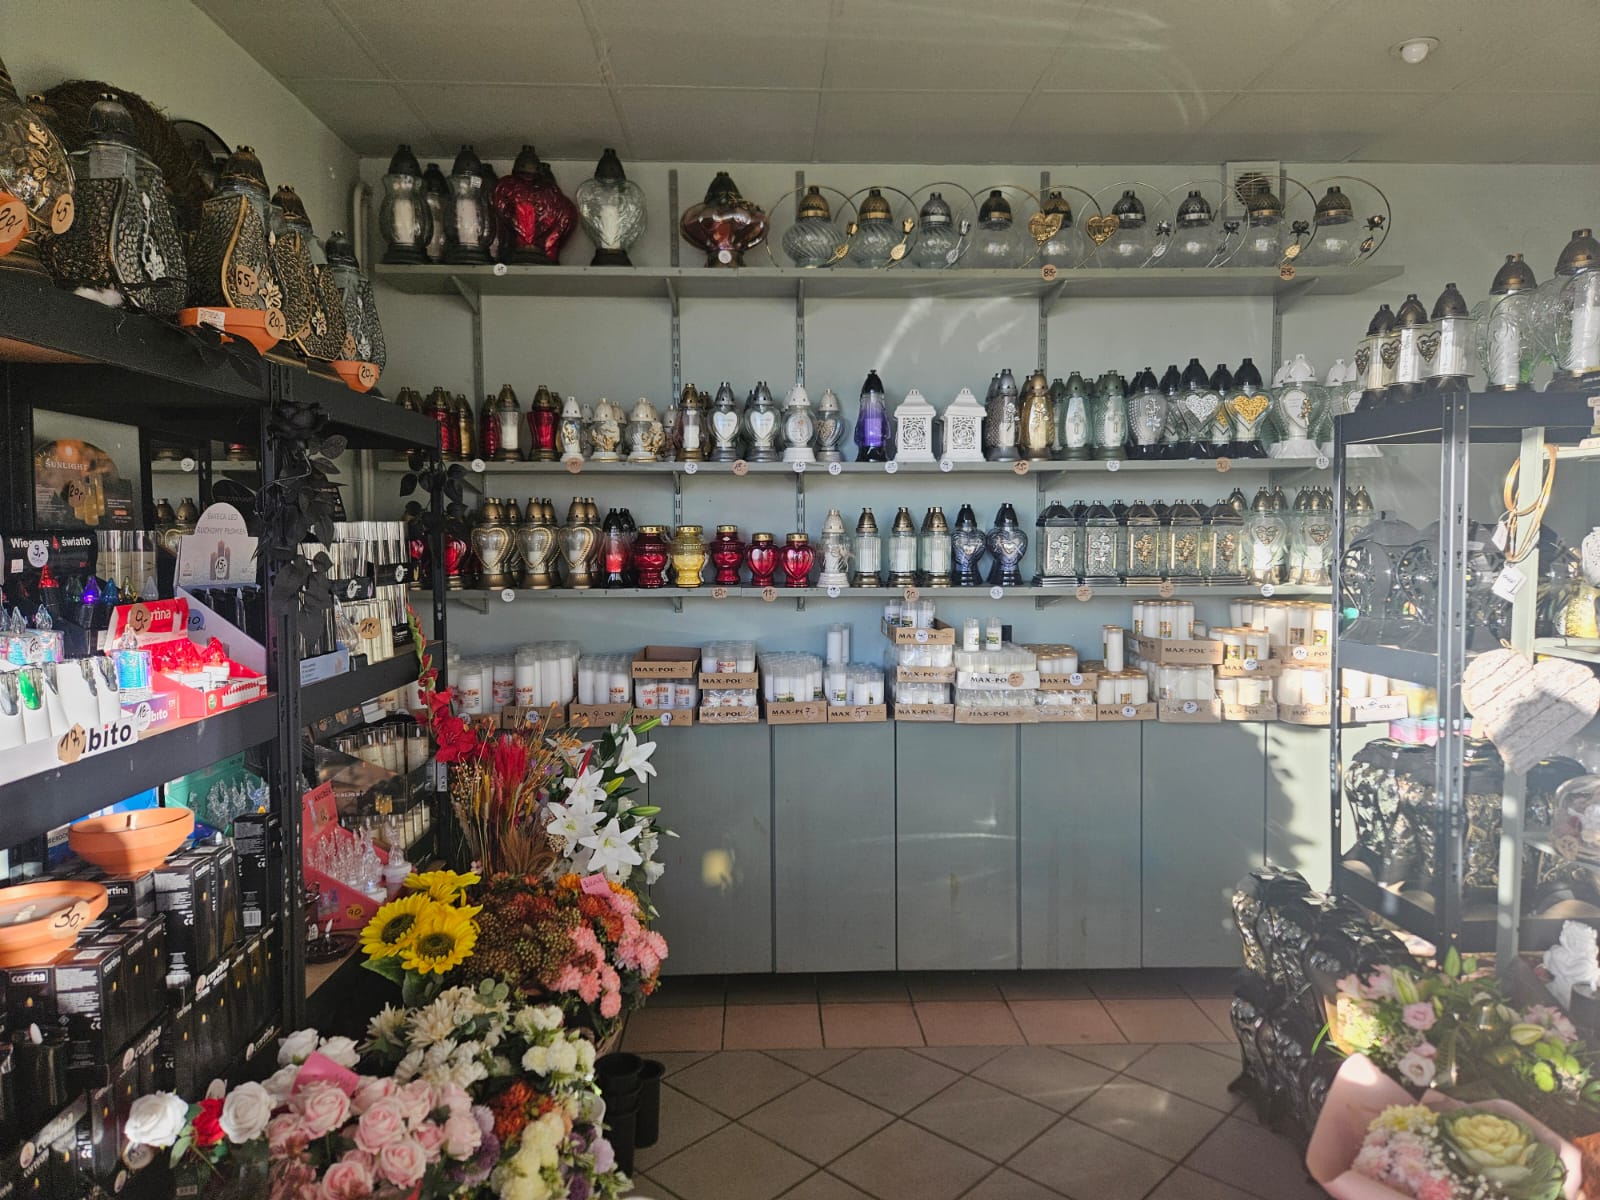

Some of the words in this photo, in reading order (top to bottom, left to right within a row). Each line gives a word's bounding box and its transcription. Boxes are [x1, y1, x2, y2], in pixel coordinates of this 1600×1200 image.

[61, 535, 92, 547] światło
[970, 676, 1008, 684] MAX-PO
[11, 971, 46, 983] cortina
